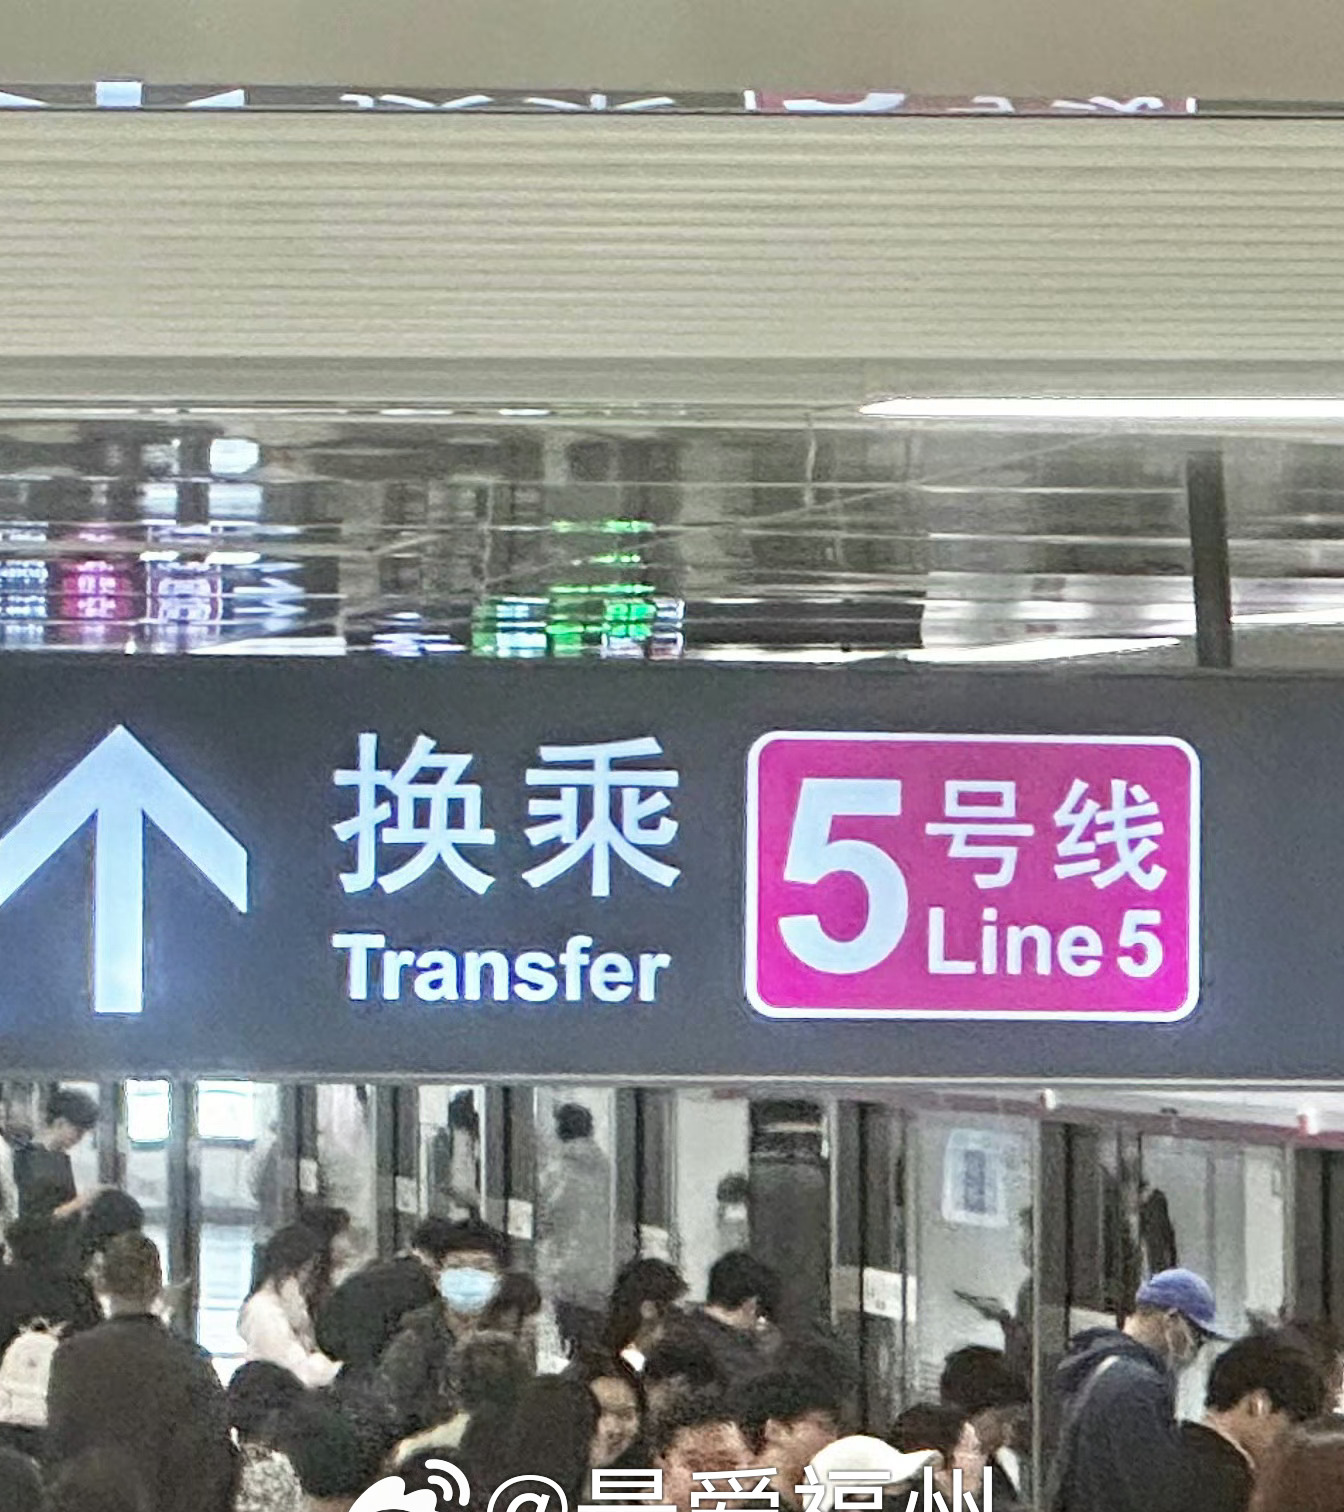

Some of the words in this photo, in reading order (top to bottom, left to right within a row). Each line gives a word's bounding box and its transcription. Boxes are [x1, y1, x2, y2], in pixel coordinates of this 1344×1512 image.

[331, 731, 682, 898] 换乘
[777, 776, 909, 974] 5
[925, 779, 1167, 890] 号线
[331, 932, 671, 1002] Transfer
[929, 908, 1104, 977] Line
[1117, 909, 1164, 978] 5
